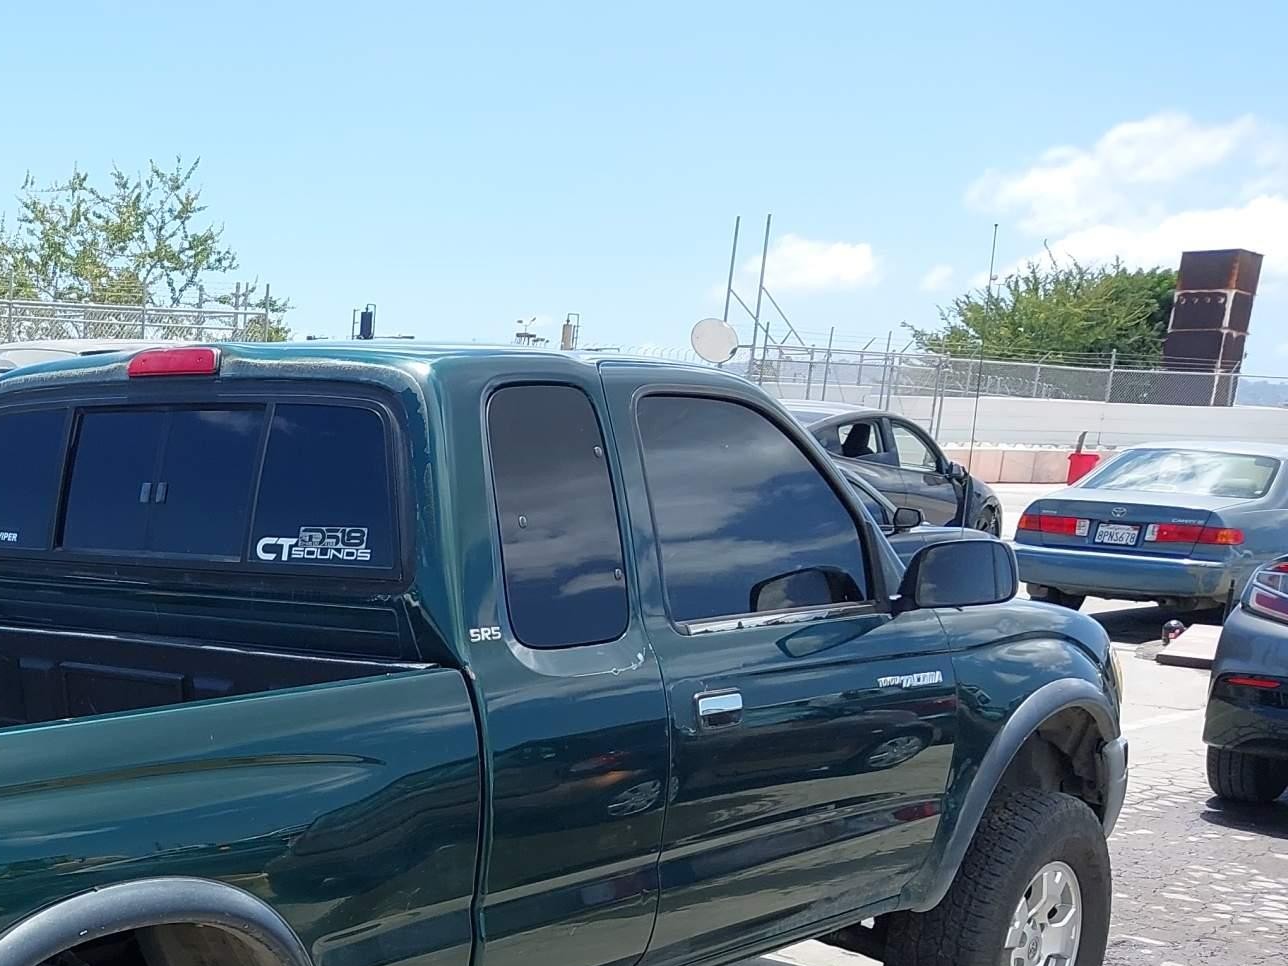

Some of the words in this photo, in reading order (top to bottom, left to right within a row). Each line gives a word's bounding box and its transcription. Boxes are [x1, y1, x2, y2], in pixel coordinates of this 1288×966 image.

[1096, 530, 1137, 543] 8PNS678
[256, 537, 298, 561] CT
[291, 547, 371, 561] SOUNDS
